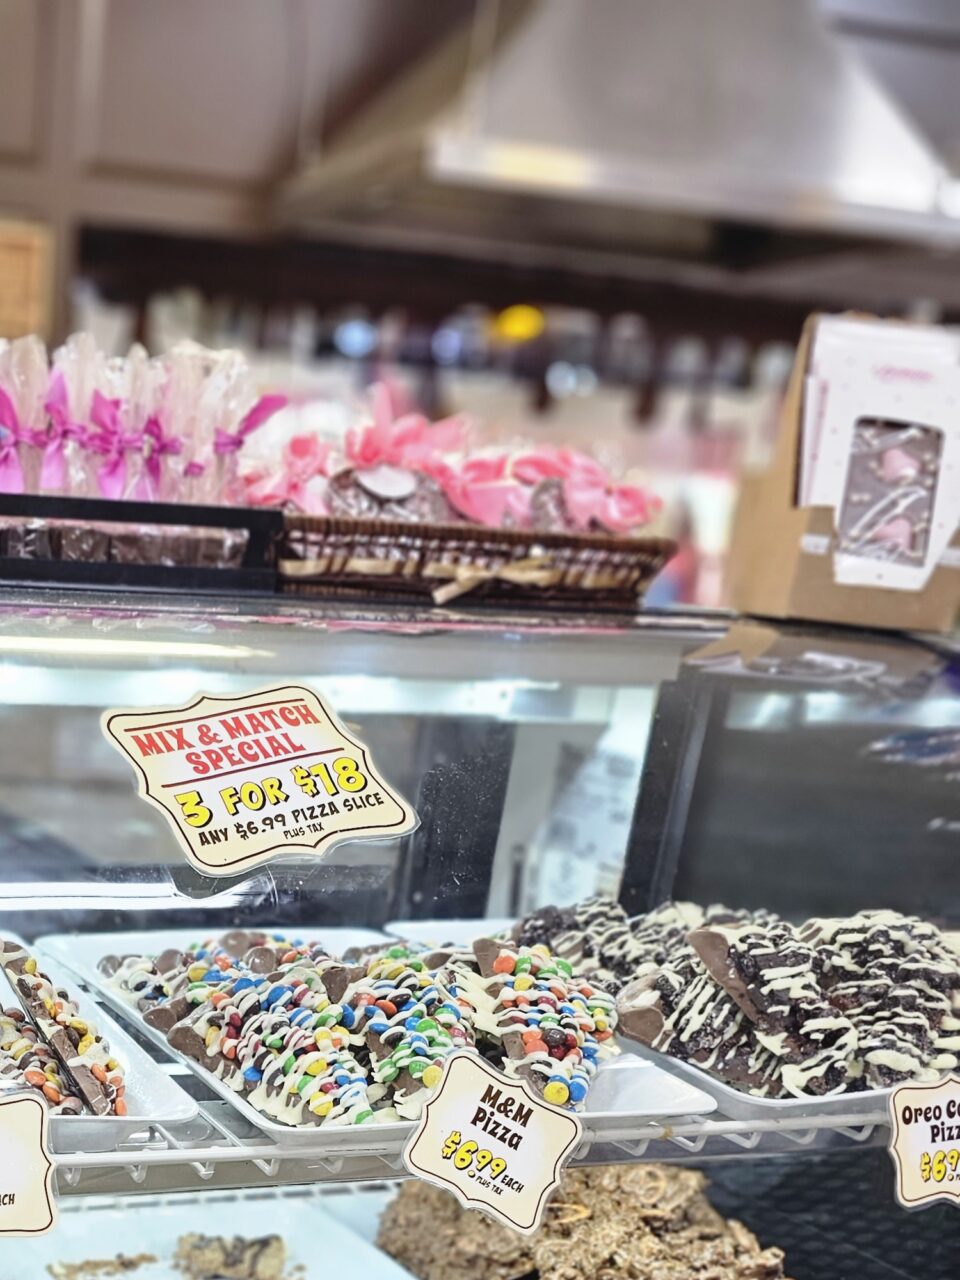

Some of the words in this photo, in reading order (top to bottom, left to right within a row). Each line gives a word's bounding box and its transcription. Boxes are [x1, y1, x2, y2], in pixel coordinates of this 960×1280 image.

[131, 728, 196, 757] MIX
[198, 724, 223, 744] &
[222, 704, 320, 740] MATCH
[185, 732, 306, 776] SPECIAL
[174, 791, 213, 828] 3
[219, 776, 290, 817] FOR
[290, 757, 368, 798] $18
[199, 827, 229, 847] ANY
[235, 813, 287, 841] $6.99
[292, 802, 340, 824] PIZZA
[343, 792, 384, 812] SLICE
[284, 827, 305, 840] PLUS
[307, 822, 325, 833] TAX
[480, 1084, 534, 1128] M&M
[902, 1105, 943, 1125] Oreo
[946, 1099, 960, 1119] C
[470, 1106, 523, 1151] Pizza
[442, 1131, 507, 1181] $6.99
[501, 1175, 525, 1194] EACH
[475, 1176, 491, 1189] PLUS
[492, 1184, 504, 1196] TAX
